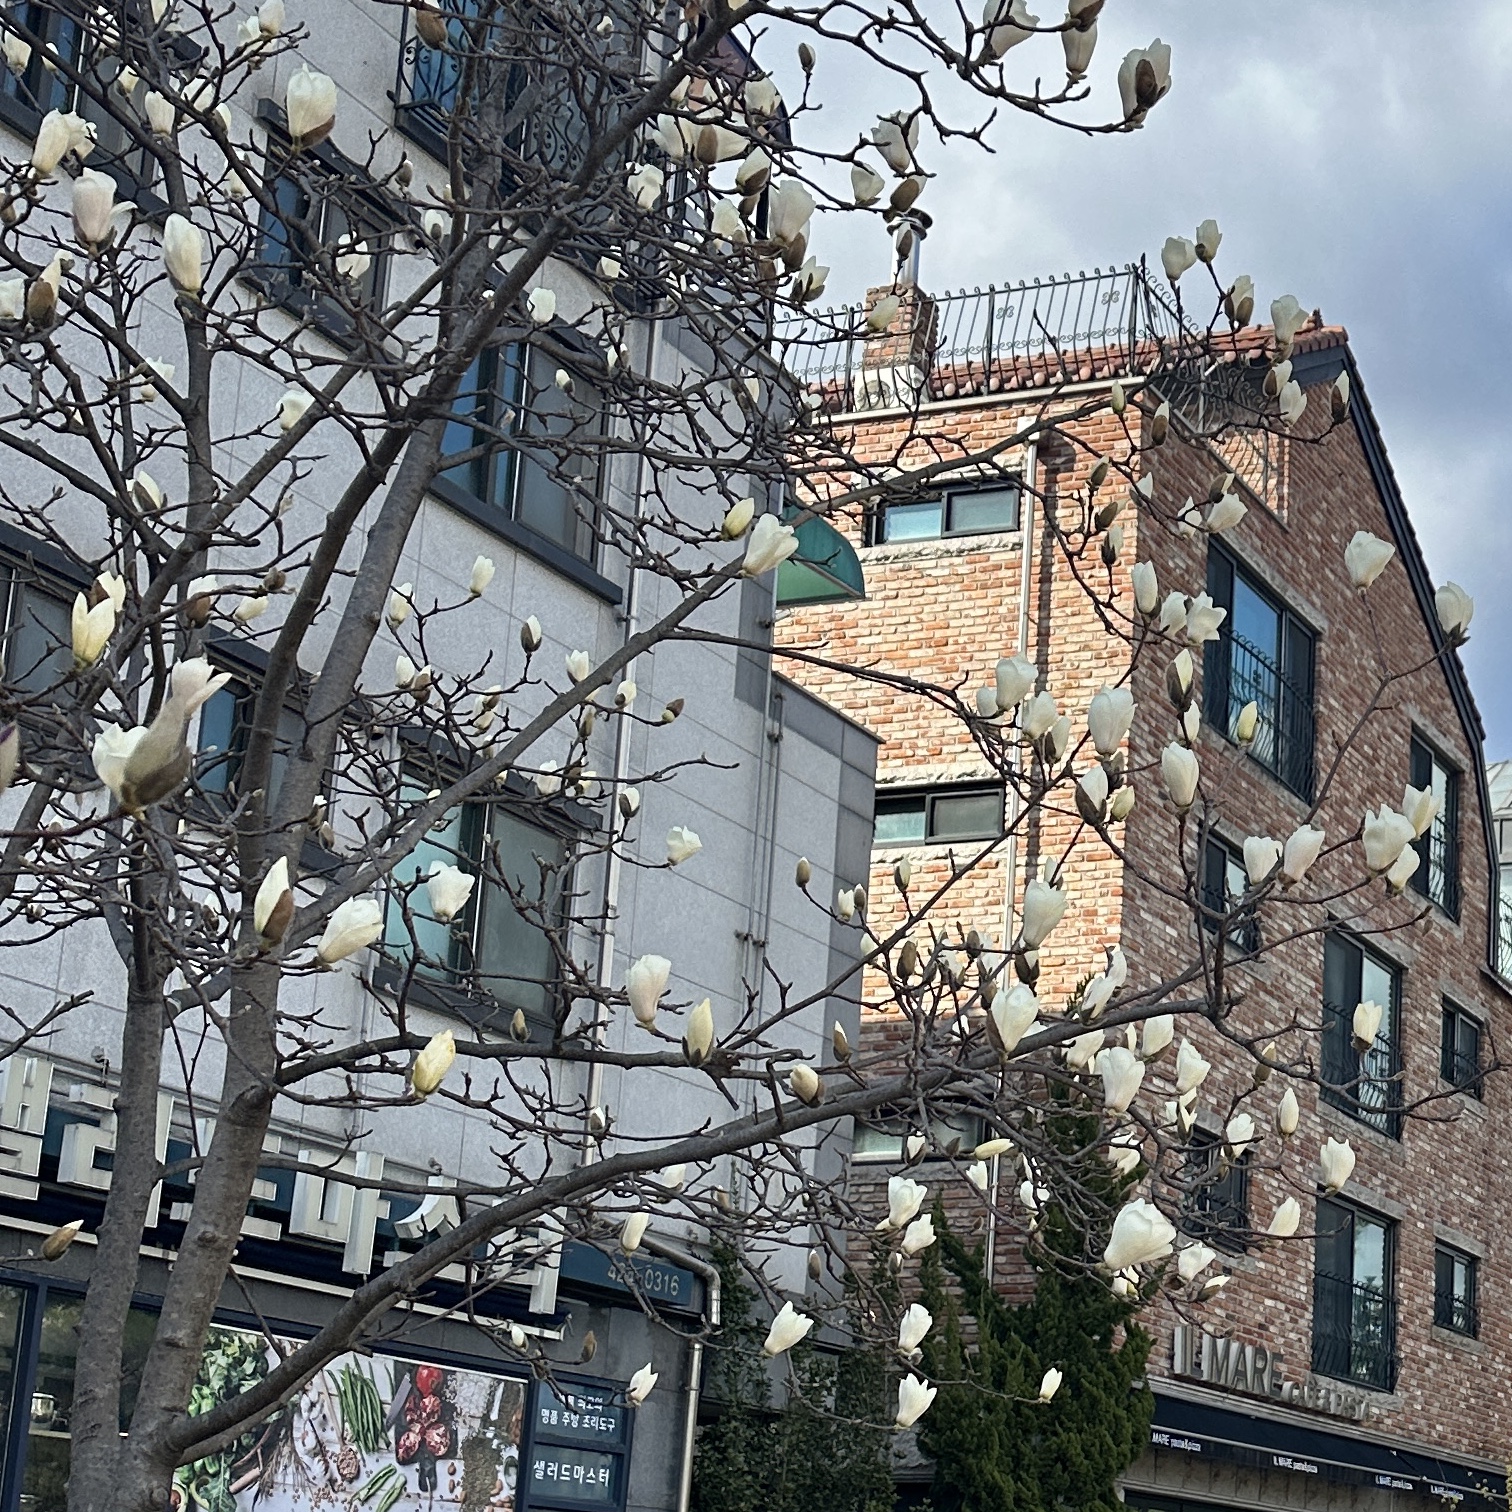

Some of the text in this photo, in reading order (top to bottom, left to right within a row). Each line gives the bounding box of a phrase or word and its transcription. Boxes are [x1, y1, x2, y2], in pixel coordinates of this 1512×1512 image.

[1202, 1333, 1284, 1398] MARE
[541, 1408, 615, 1432] 명품 주방 조리도구
[533, 1460, 610, 1487] 샐러드마스터
